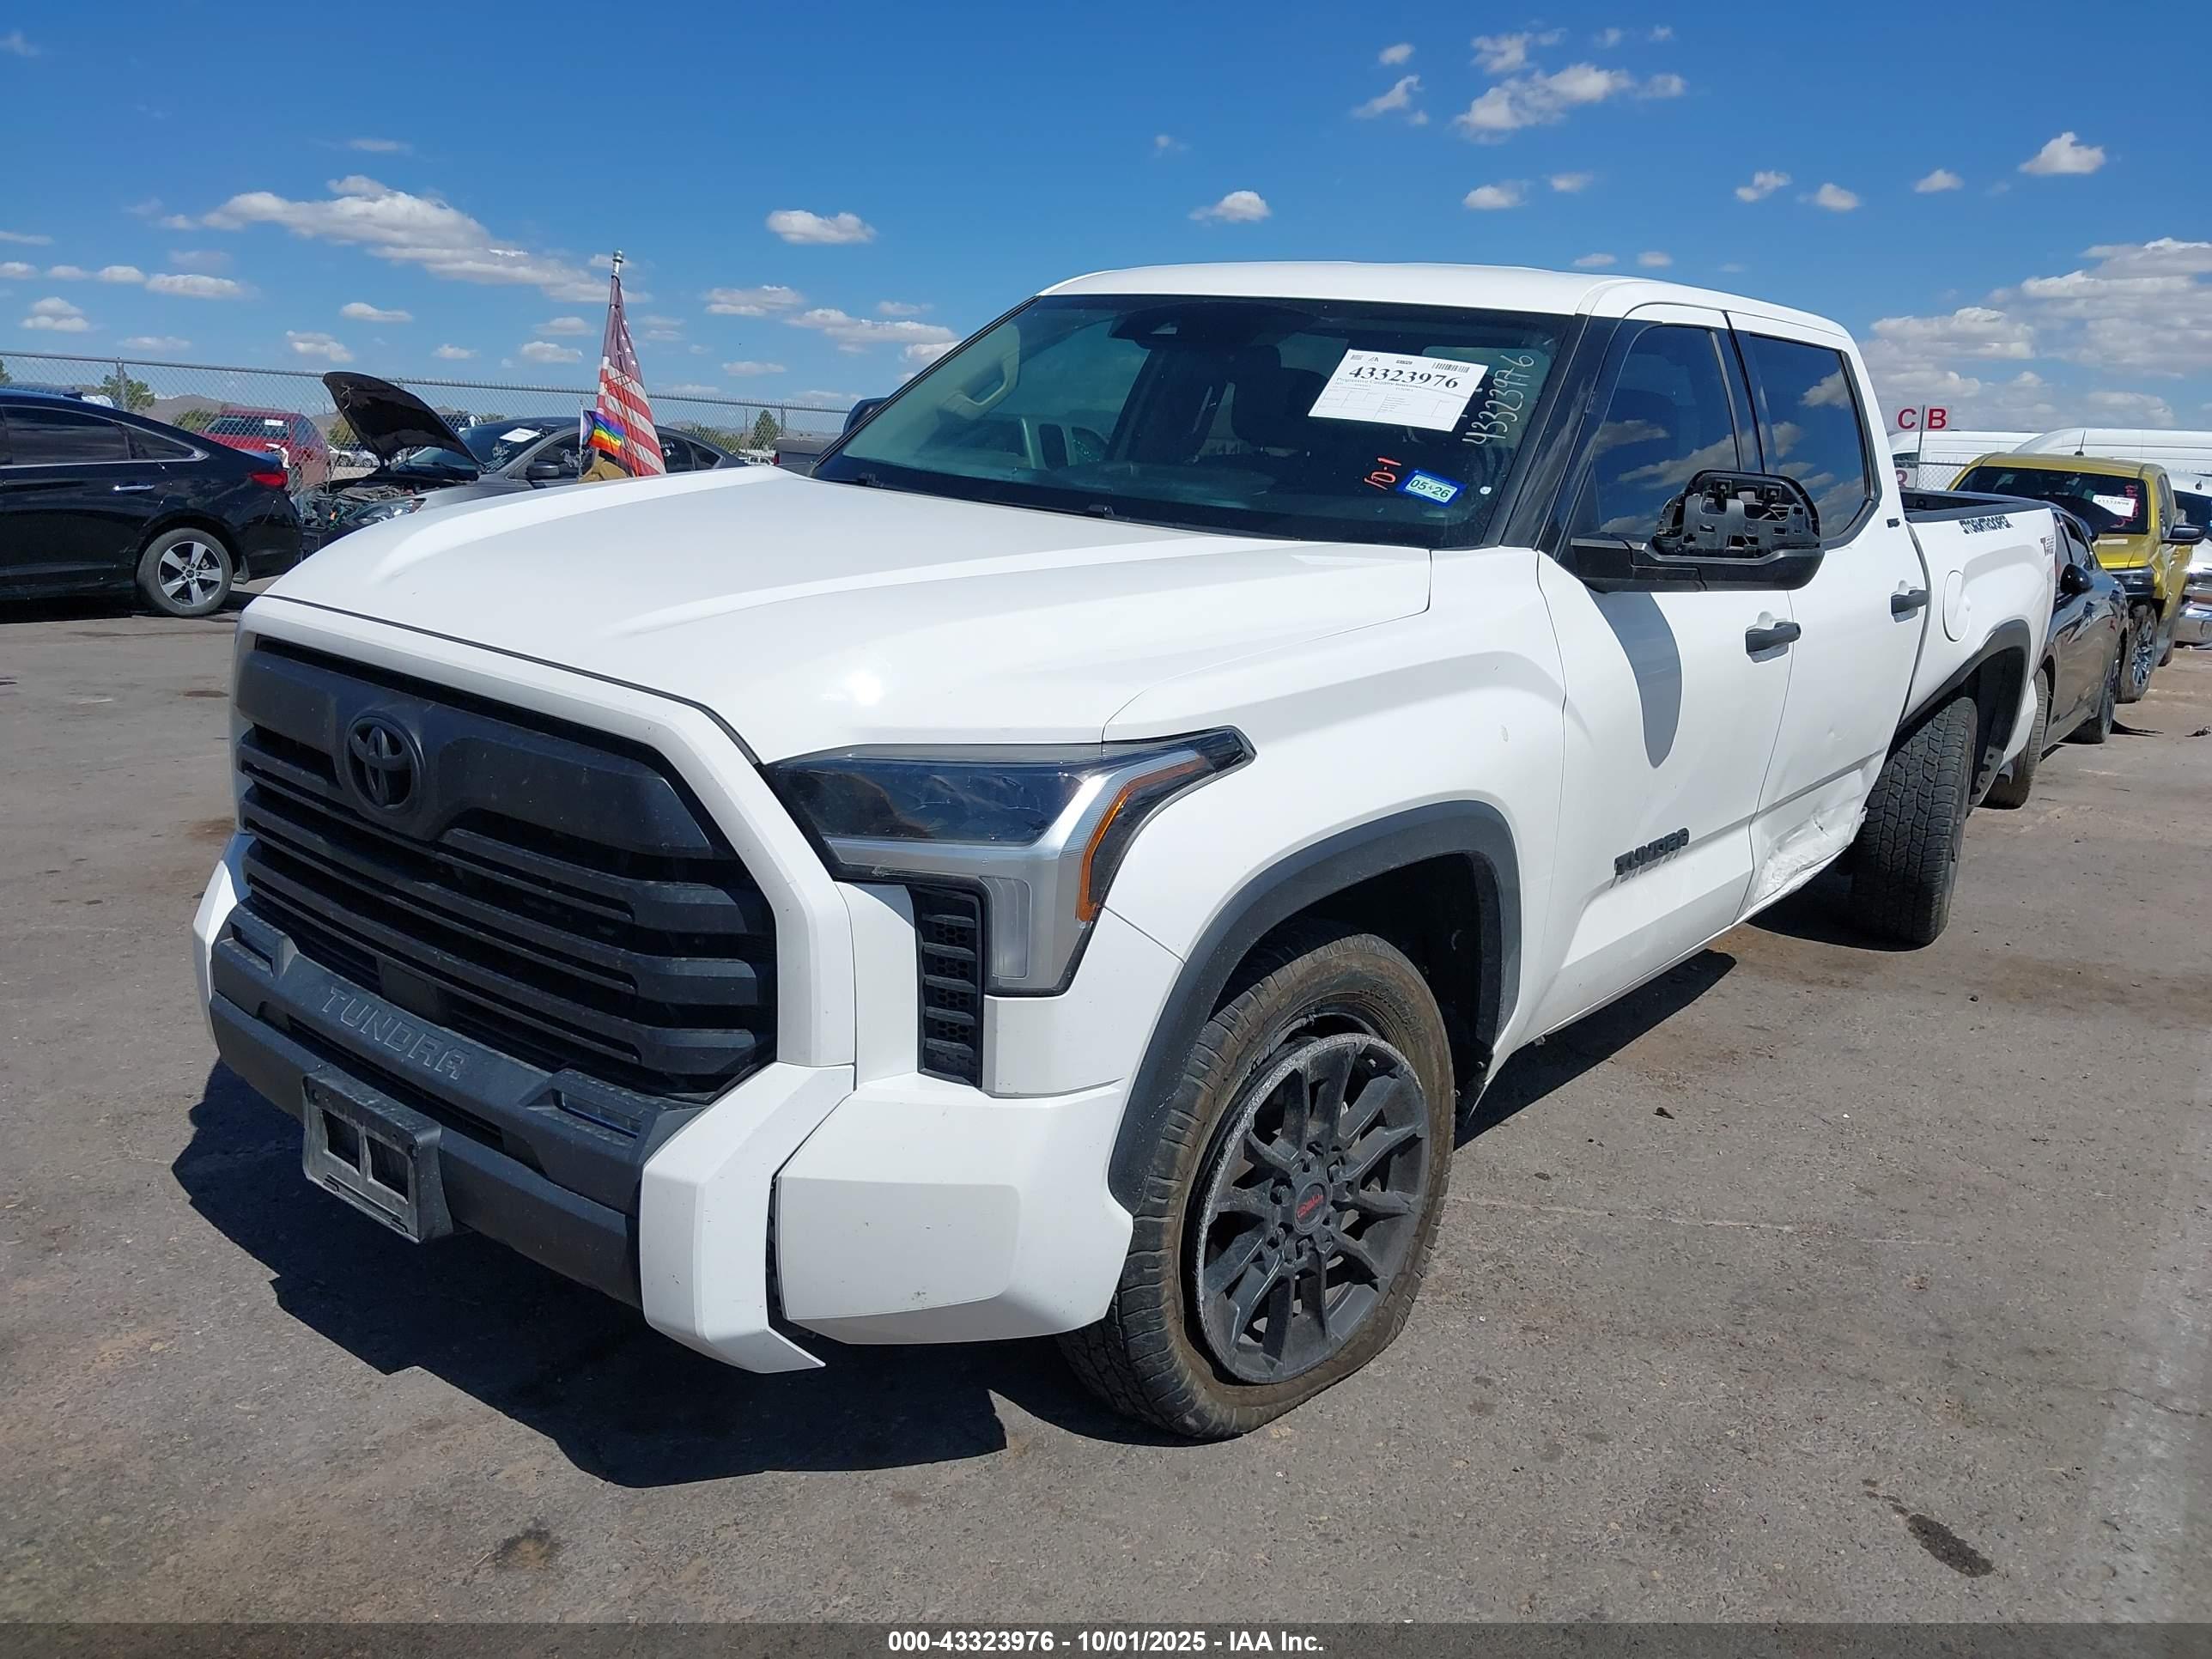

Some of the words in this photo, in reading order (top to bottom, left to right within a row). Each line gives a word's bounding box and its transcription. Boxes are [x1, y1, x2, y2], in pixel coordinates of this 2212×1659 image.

[1349, 366, 1460, 389] 43323976
[1462, 356, 1534, 445] 43323976
[1897, 408, 1917, 429] C
[1928, 408, 1947, 429] B
[321, 987, 471, 1080] TUNDRA
